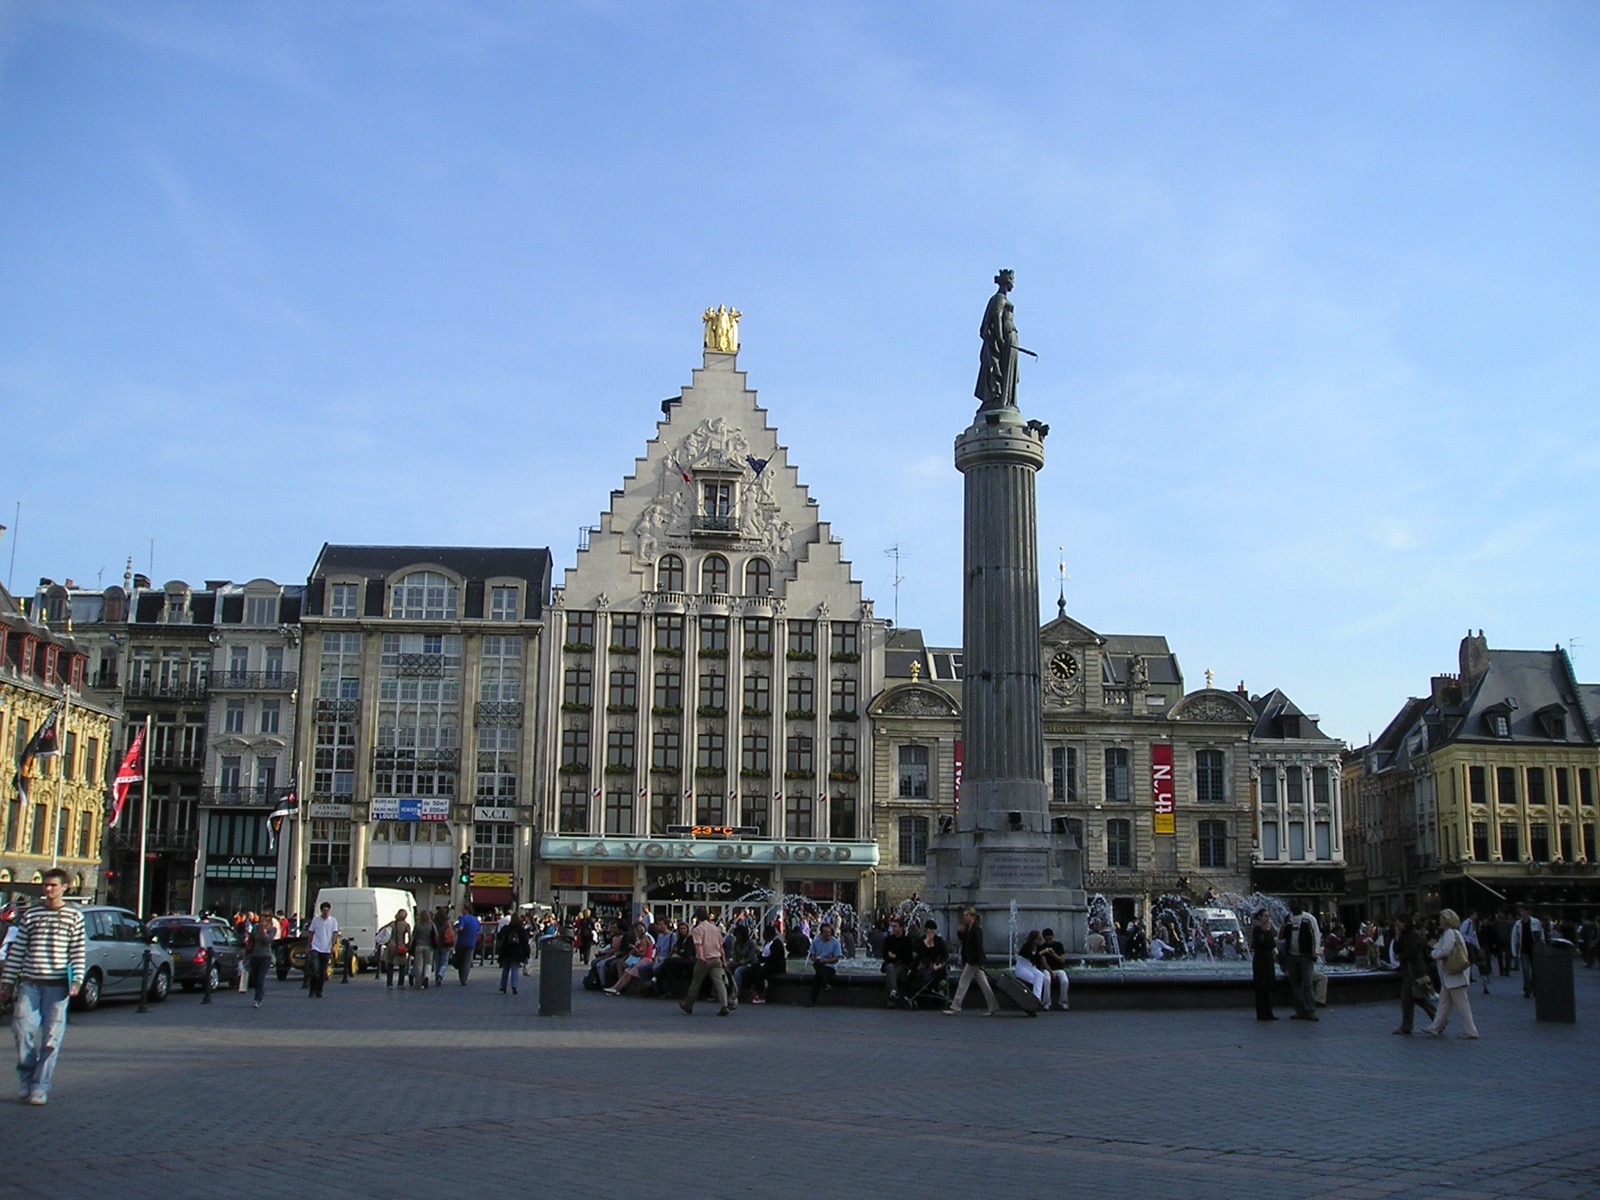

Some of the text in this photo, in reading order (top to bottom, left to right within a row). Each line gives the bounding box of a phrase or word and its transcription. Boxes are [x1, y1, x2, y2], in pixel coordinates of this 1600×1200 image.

[570, 841, 852, 862] LA VOIX DU NORD
[228, 857, 255, 865] ZARA
[396, 875, 423, 884] ZARA
[717, 868, 761, 888] PLACE
[684, 879, 732, 893] fnac
